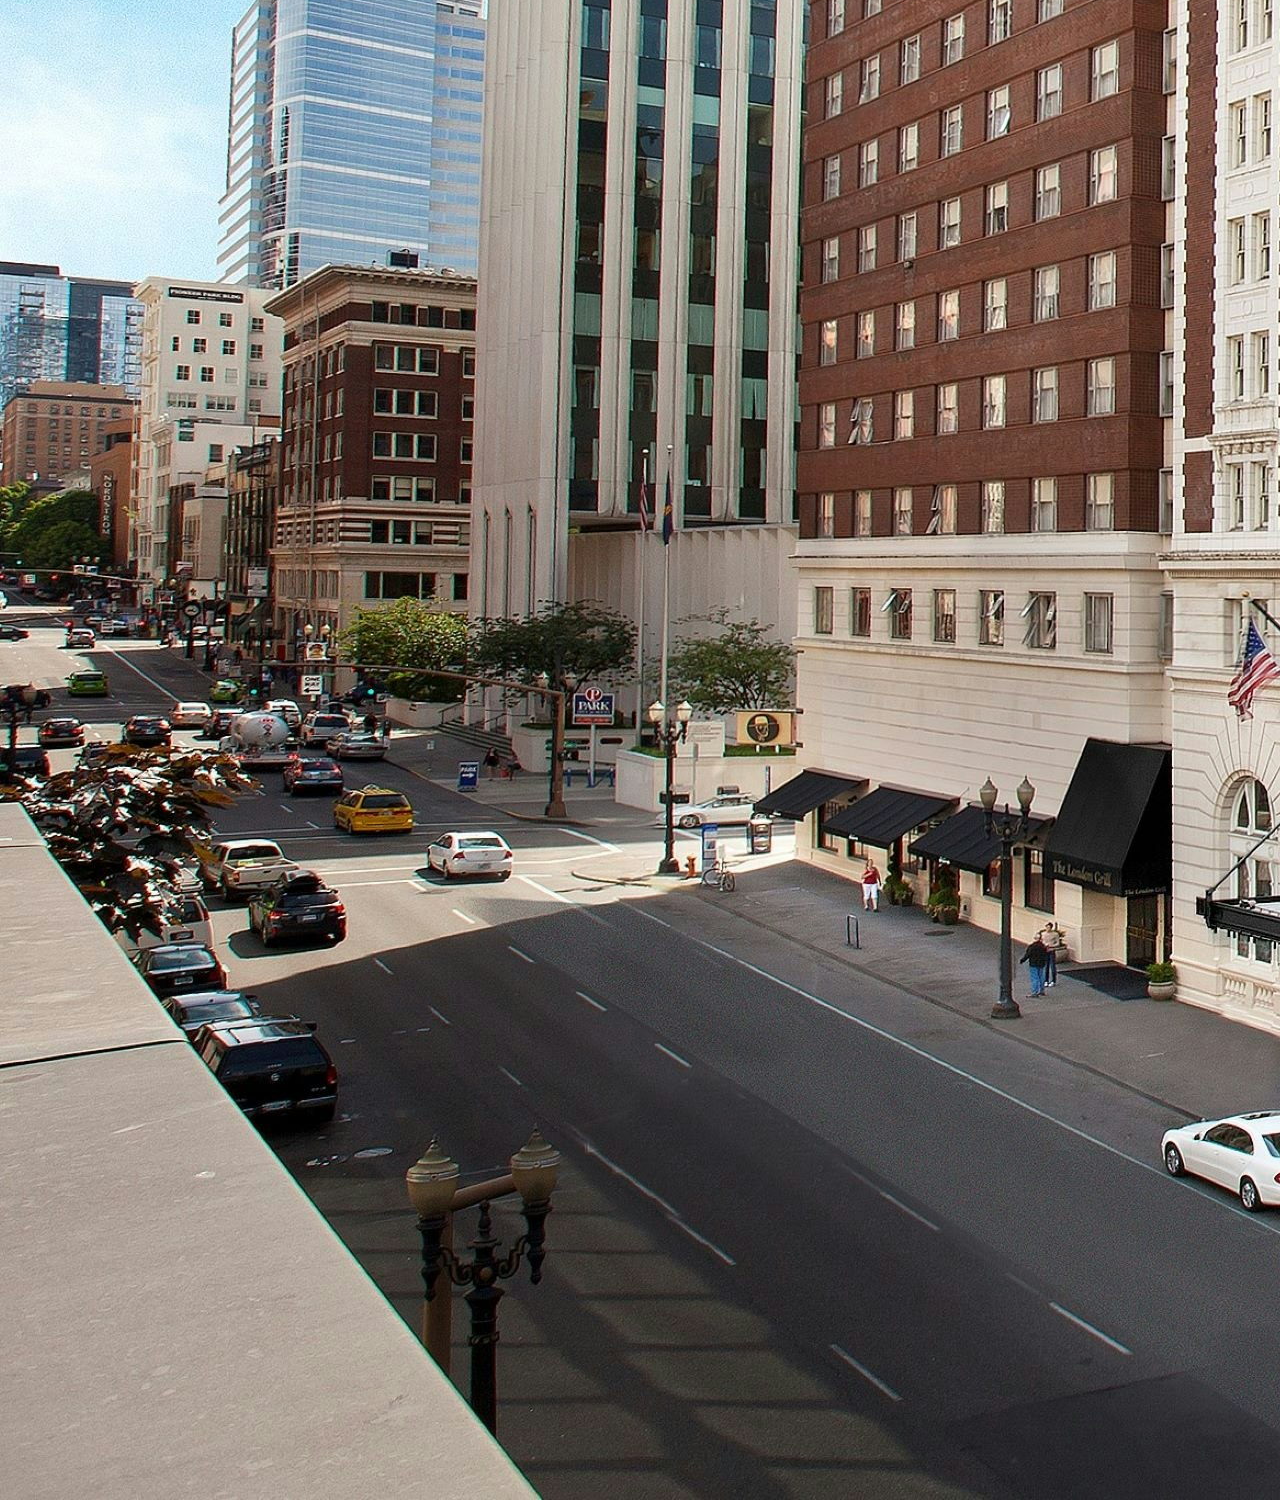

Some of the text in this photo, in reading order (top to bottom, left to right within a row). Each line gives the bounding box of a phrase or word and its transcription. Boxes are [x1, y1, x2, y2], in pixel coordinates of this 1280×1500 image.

[102, 474, 113, 535] NORDSTROM
[579, 701, 610, 711] PARK
[1053, 860, 1112, 888] The London Grill
